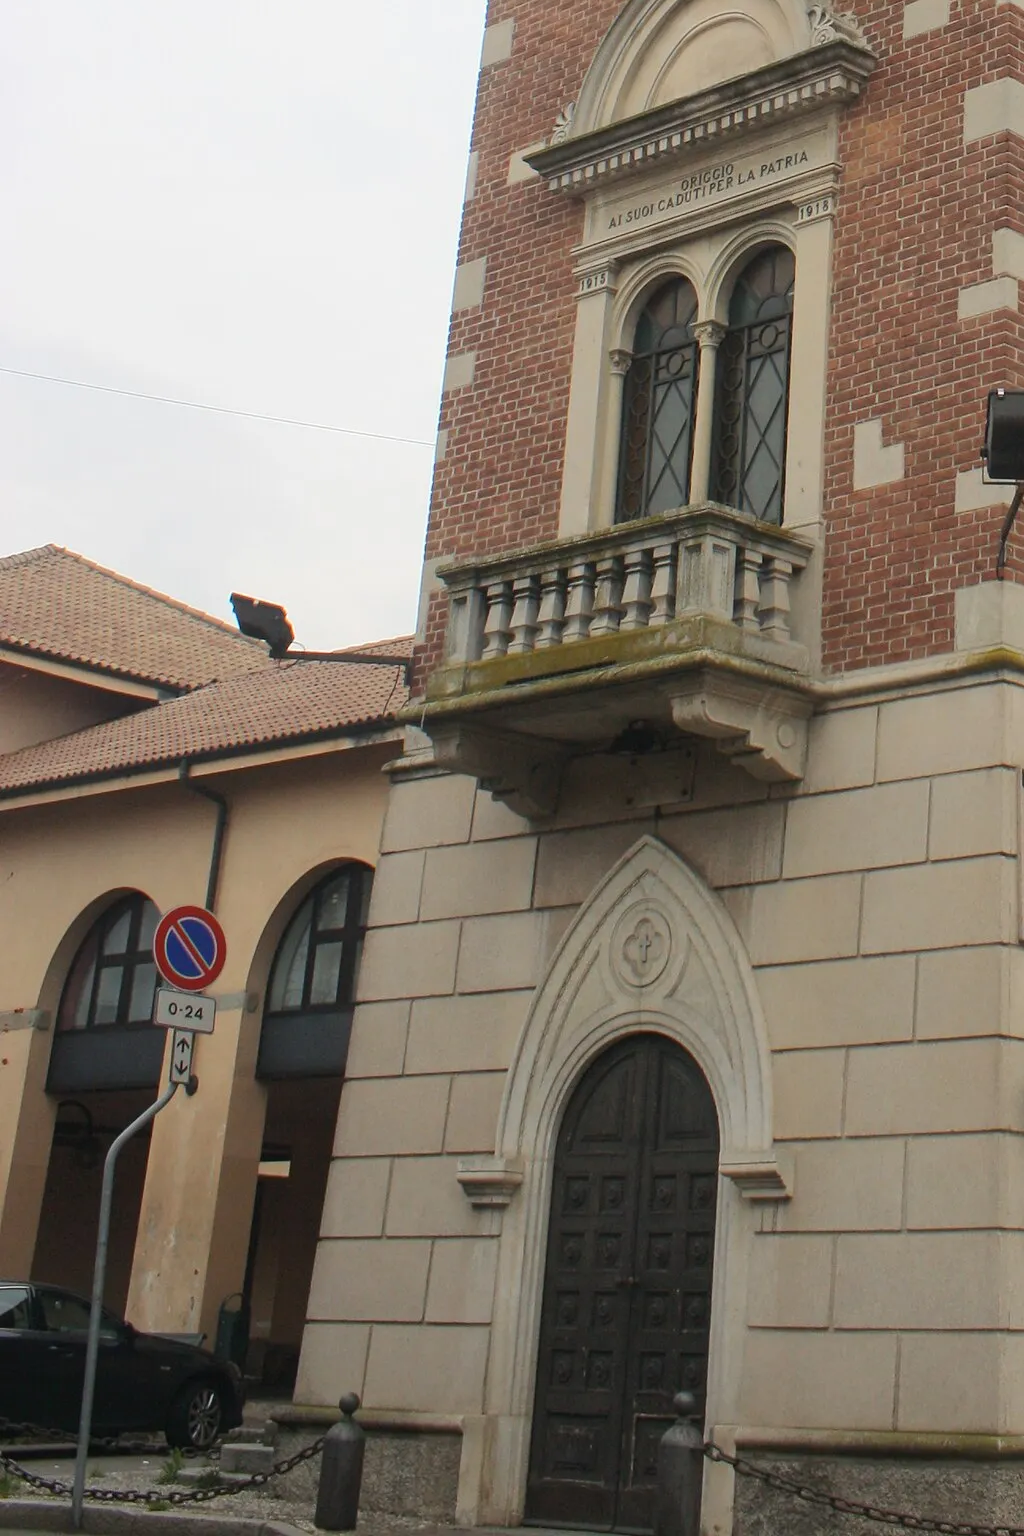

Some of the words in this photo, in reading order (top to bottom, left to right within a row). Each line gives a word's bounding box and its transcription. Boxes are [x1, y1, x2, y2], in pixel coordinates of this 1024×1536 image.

[681, 164, 734, 191] ORIGGIO
[608, 214, 622, 229] AI
[626, 203, 655, 223] SUOI
[657, 185, 706, 212] CADUTI
[709, 177, 733, 195] PER
[737, 170, 755, 185] LA
[760, 150, 808, 177] PATRIA
[800, 200, 829, 220] 1918
[581, 272, 606, 291] 1915
[168, 1002, 203, 1020] 0-24
